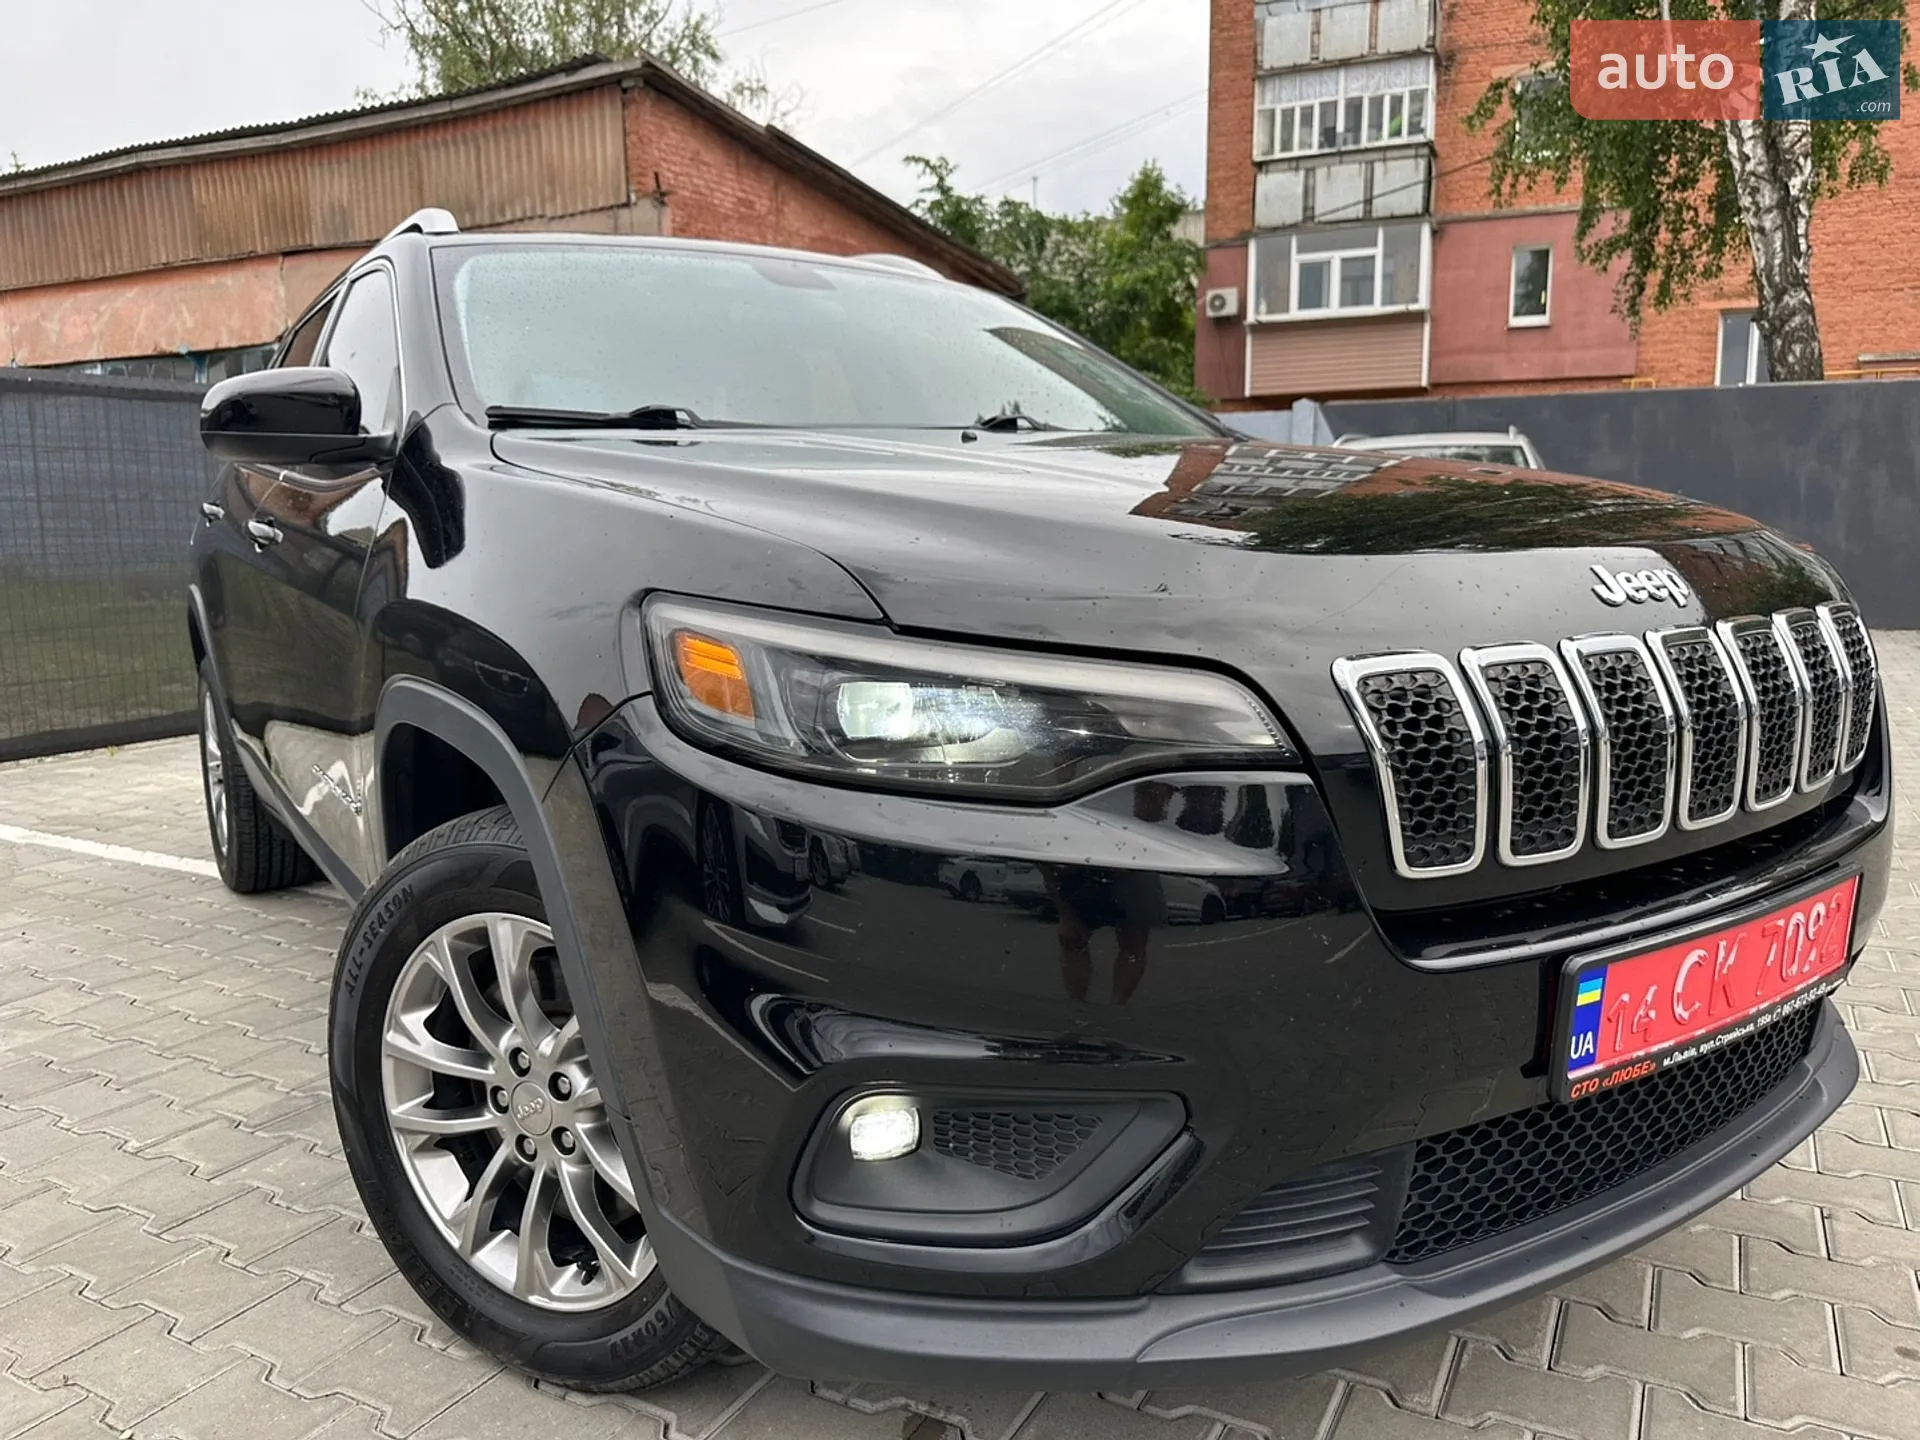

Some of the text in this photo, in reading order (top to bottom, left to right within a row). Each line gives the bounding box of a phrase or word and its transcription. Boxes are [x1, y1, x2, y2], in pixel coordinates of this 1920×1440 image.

[1589, 564, 1691, 608] Jeep
[344, 883, 417, 999] ALL-SEASON
[1570, 1030, 1594, 1060] UA
[517, 1096, 545, 1120] Jeep
